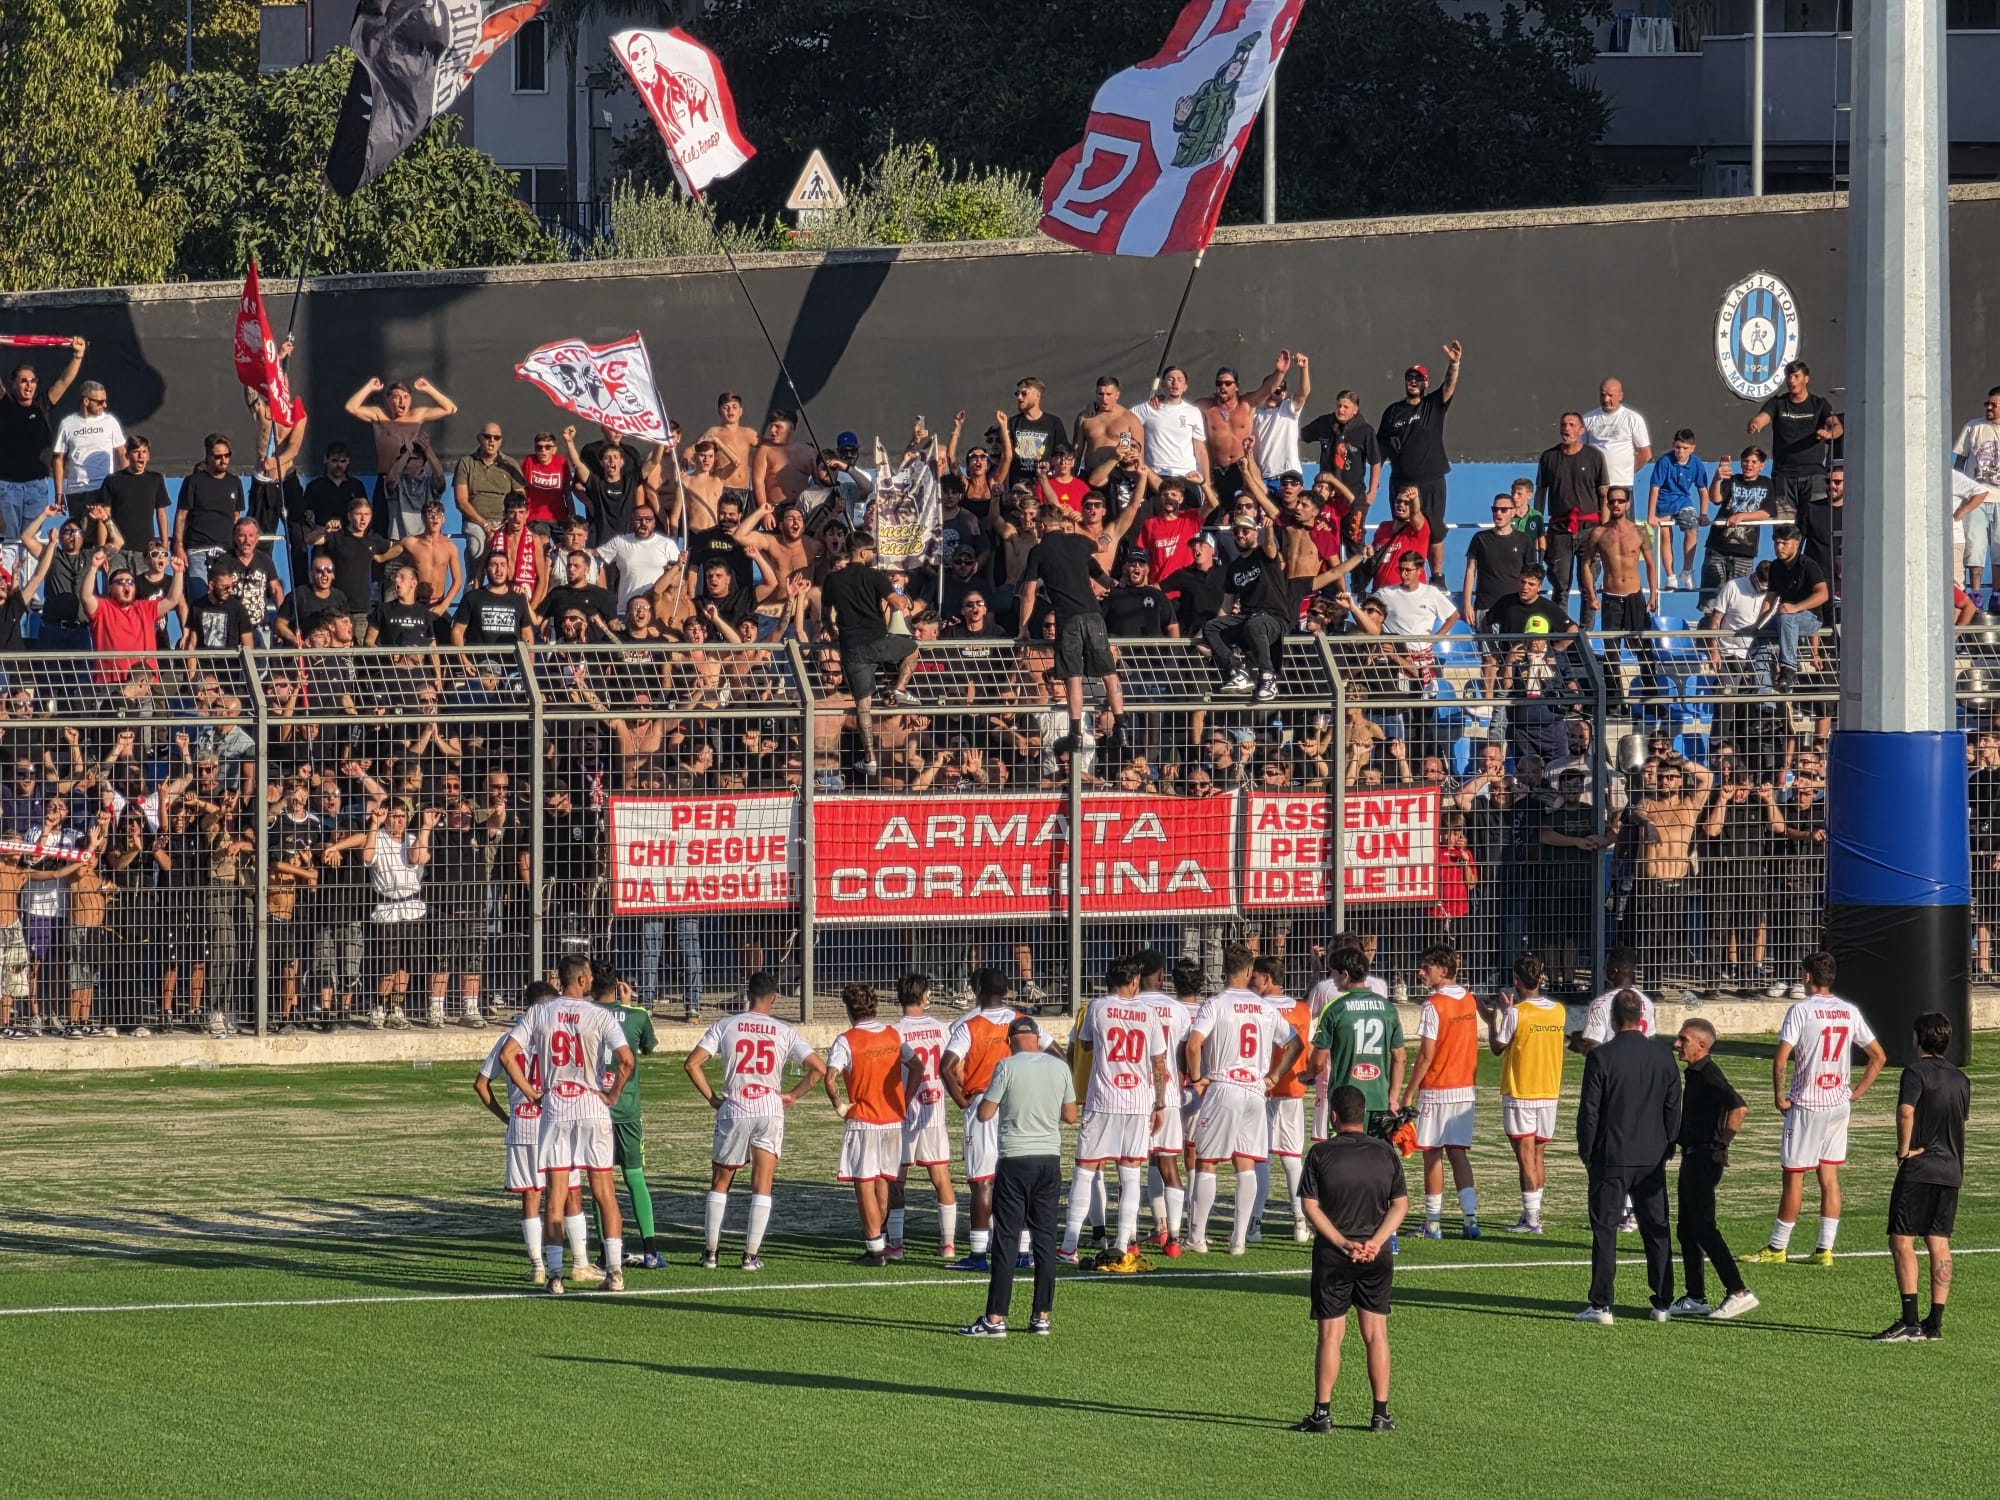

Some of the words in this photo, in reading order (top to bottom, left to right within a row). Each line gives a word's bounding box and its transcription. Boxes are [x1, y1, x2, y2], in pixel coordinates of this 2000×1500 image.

[1722, 276, 1796, 323] GLADIATOR
[1728, 370, 1773, 397] MARIA
[1745, 364, 1768, 373] 1924
[73, 426, 104, 437] adidas
[671, 803, 736, 831] PER
[1257, 797, 1428, 830] ASSENTI
[875, 812, 1168, 850] ARMATA
[1355, 832, 1410, 860] UN
[628, 840, 676, 867] CHI
[686, 835, 786, 866] SEGUE
[622, 878, 655, 902] DA
[829, 859, 1213, 901] CORALLINA
[1107, 1007, 1147, 1022] SALZANO
[1233, 1003, 1263, 1014] CAPONE
[737, 1022, 777, 1035] CASELLA
[1106, 1026, 1146, 1064] 20
[1240, 1023, 1257, 1059] 6
[1353, 1018, 1384, 1055] 12
[1821, 1026, 1849, 1062] 17
[551, 1030, 584, 1068] 91
[735, 1039, 776, 1075] 25
[913, 1044, 941, 1082] 21
